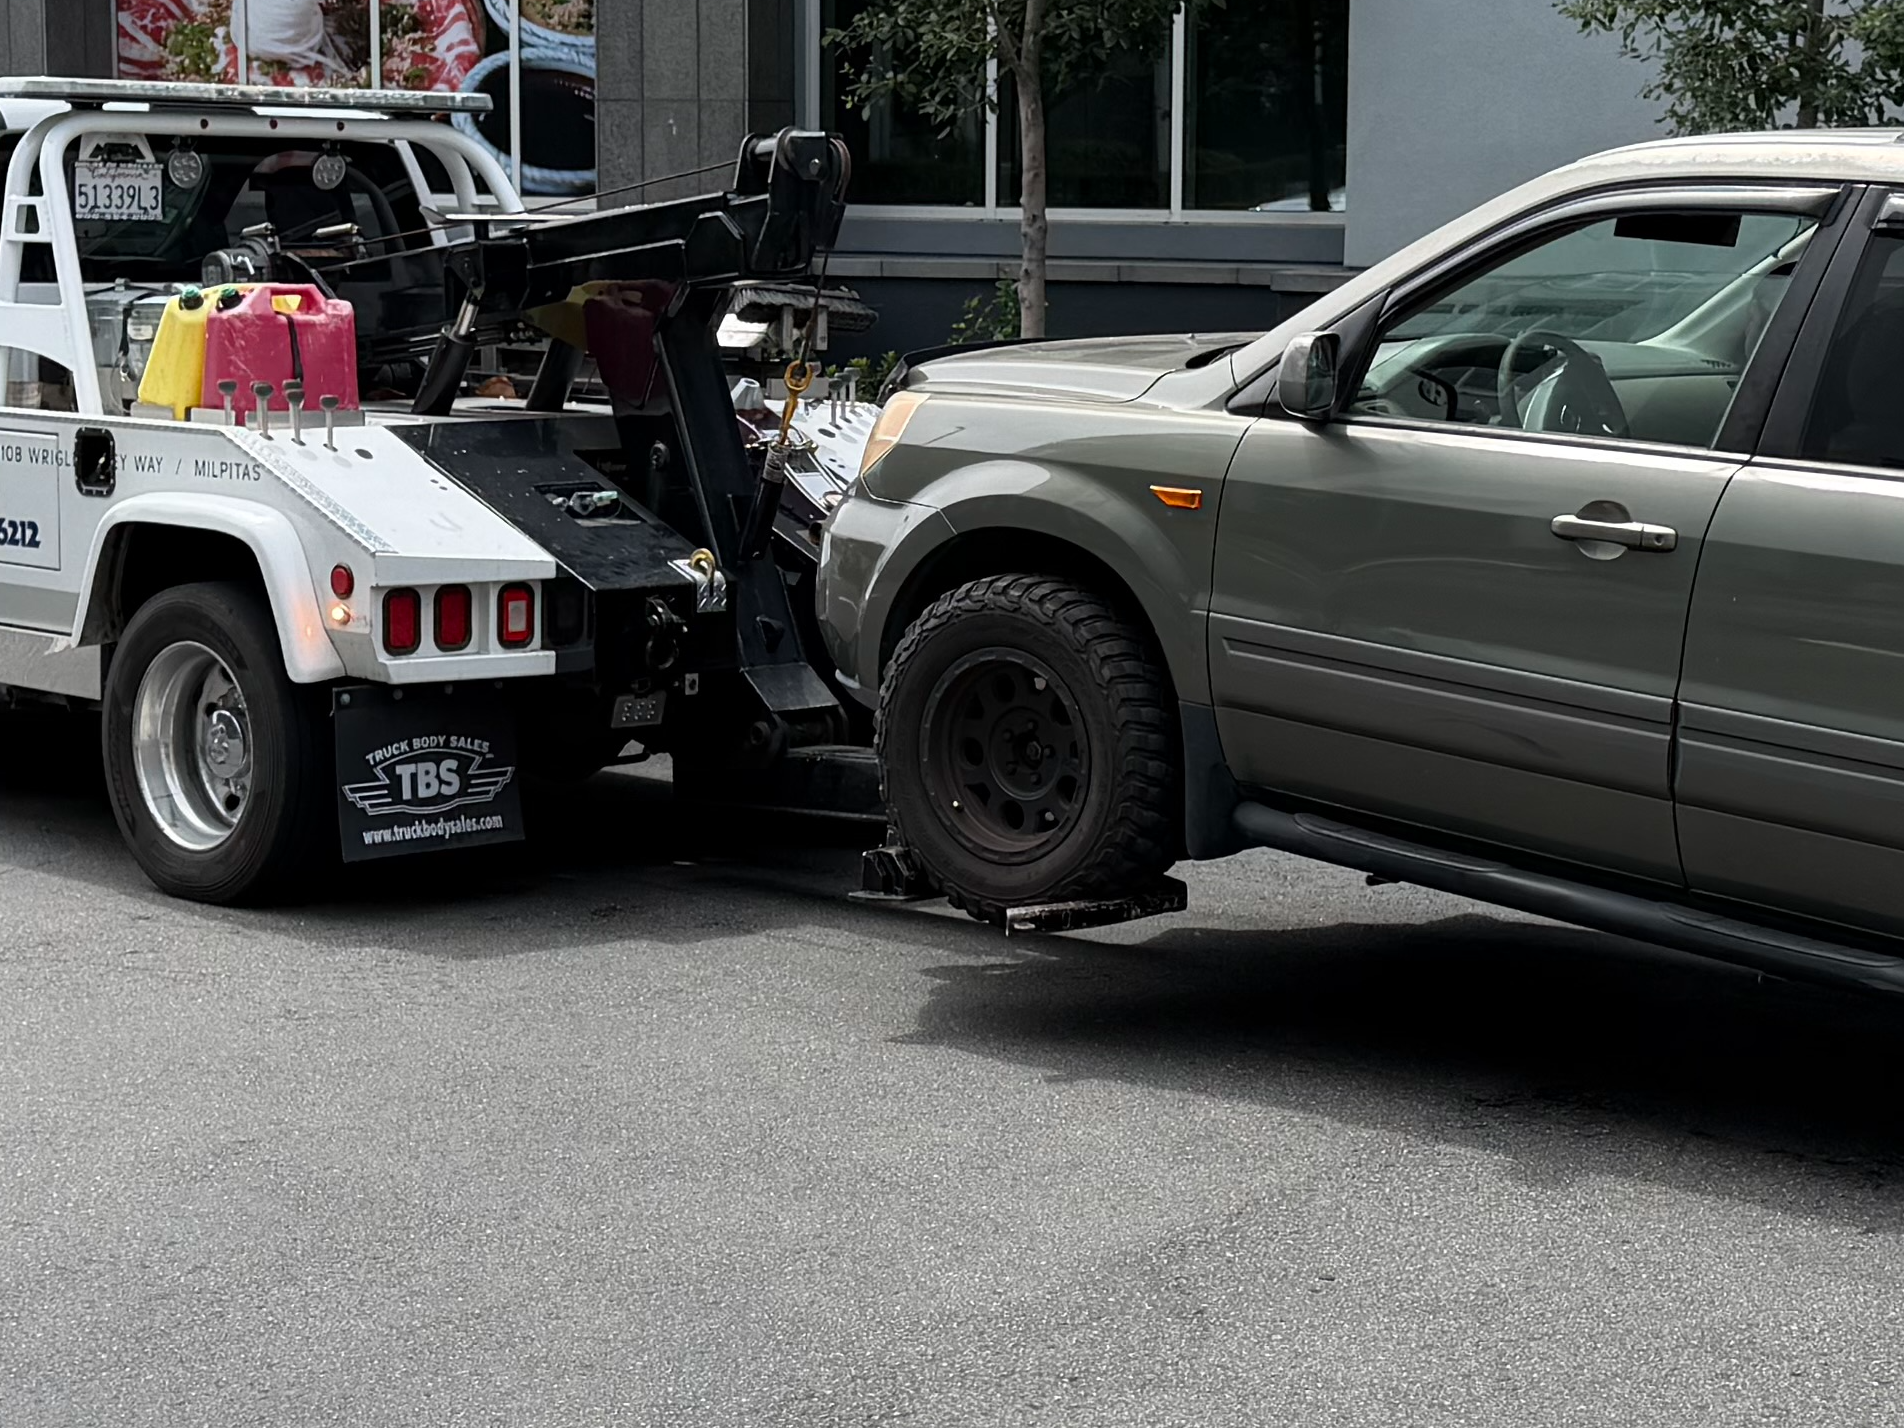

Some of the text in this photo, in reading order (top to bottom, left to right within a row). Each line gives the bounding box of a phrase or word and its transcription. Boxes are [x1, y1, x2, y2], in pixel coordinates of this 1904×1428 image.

[78, 183, 160, 211] 51339L3
[134, 455, 164, 474] WAY
[194, 458, 262, 482] MILPITAS
[365, 734, 491, 766] TRUCK BODY SALES
[396, 758, 462, 801] TBS
[362, 814, 504, 845] www.truckbodysales.com
